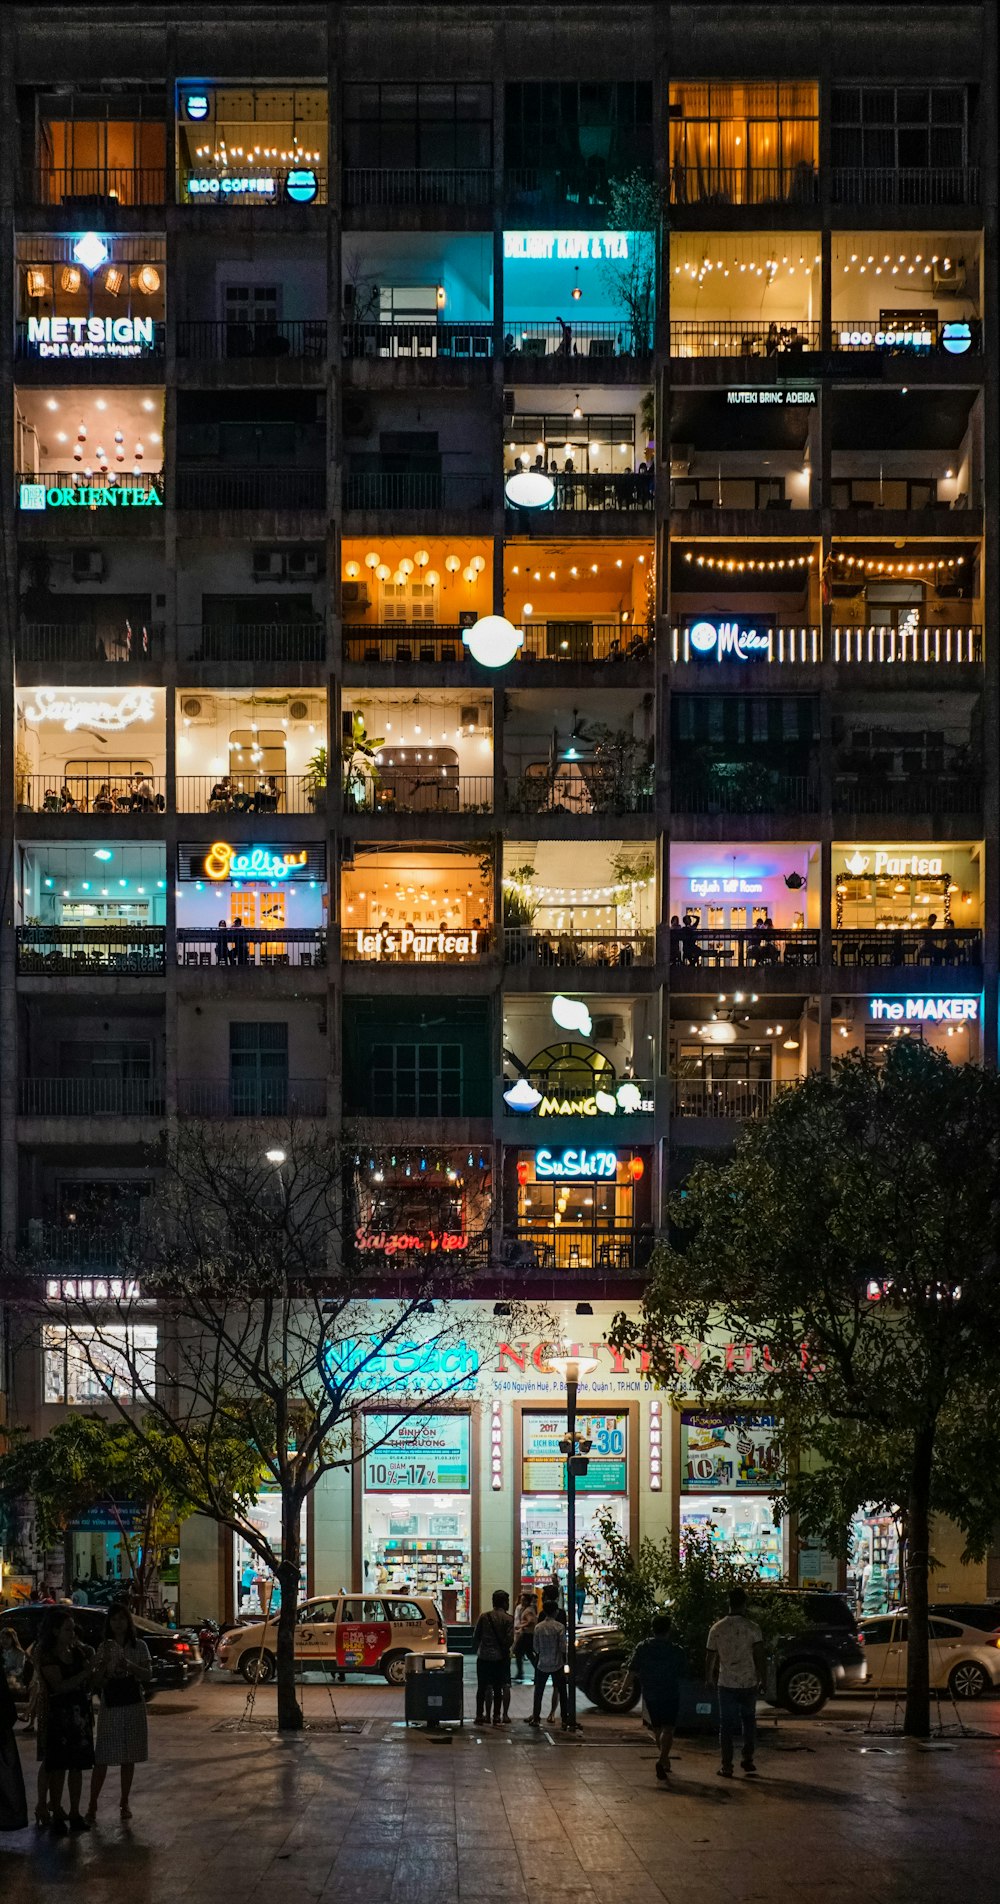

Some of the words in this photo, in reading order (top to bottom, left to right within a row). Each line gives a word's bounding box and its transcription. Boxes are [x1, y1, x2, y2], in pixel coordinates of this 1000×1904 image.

[188, 179, 219, 192] BOO
[221, 178, 274, 192] COFFEE
[28, 317, 152, 342] METSIGN
[840, 332, 872, 345] BOO
[874, 332, 931, 345] COFFEE
[46, 487, 163, 506] ORIENTEA
[874, 851, 942, 876] Partea
[400, 929, 478, 954] Partea!
[870, 999, 904, 1019] the
[906, 999, 977, 1019] MAKER
[540, 1424, 559, 1433] 2017
